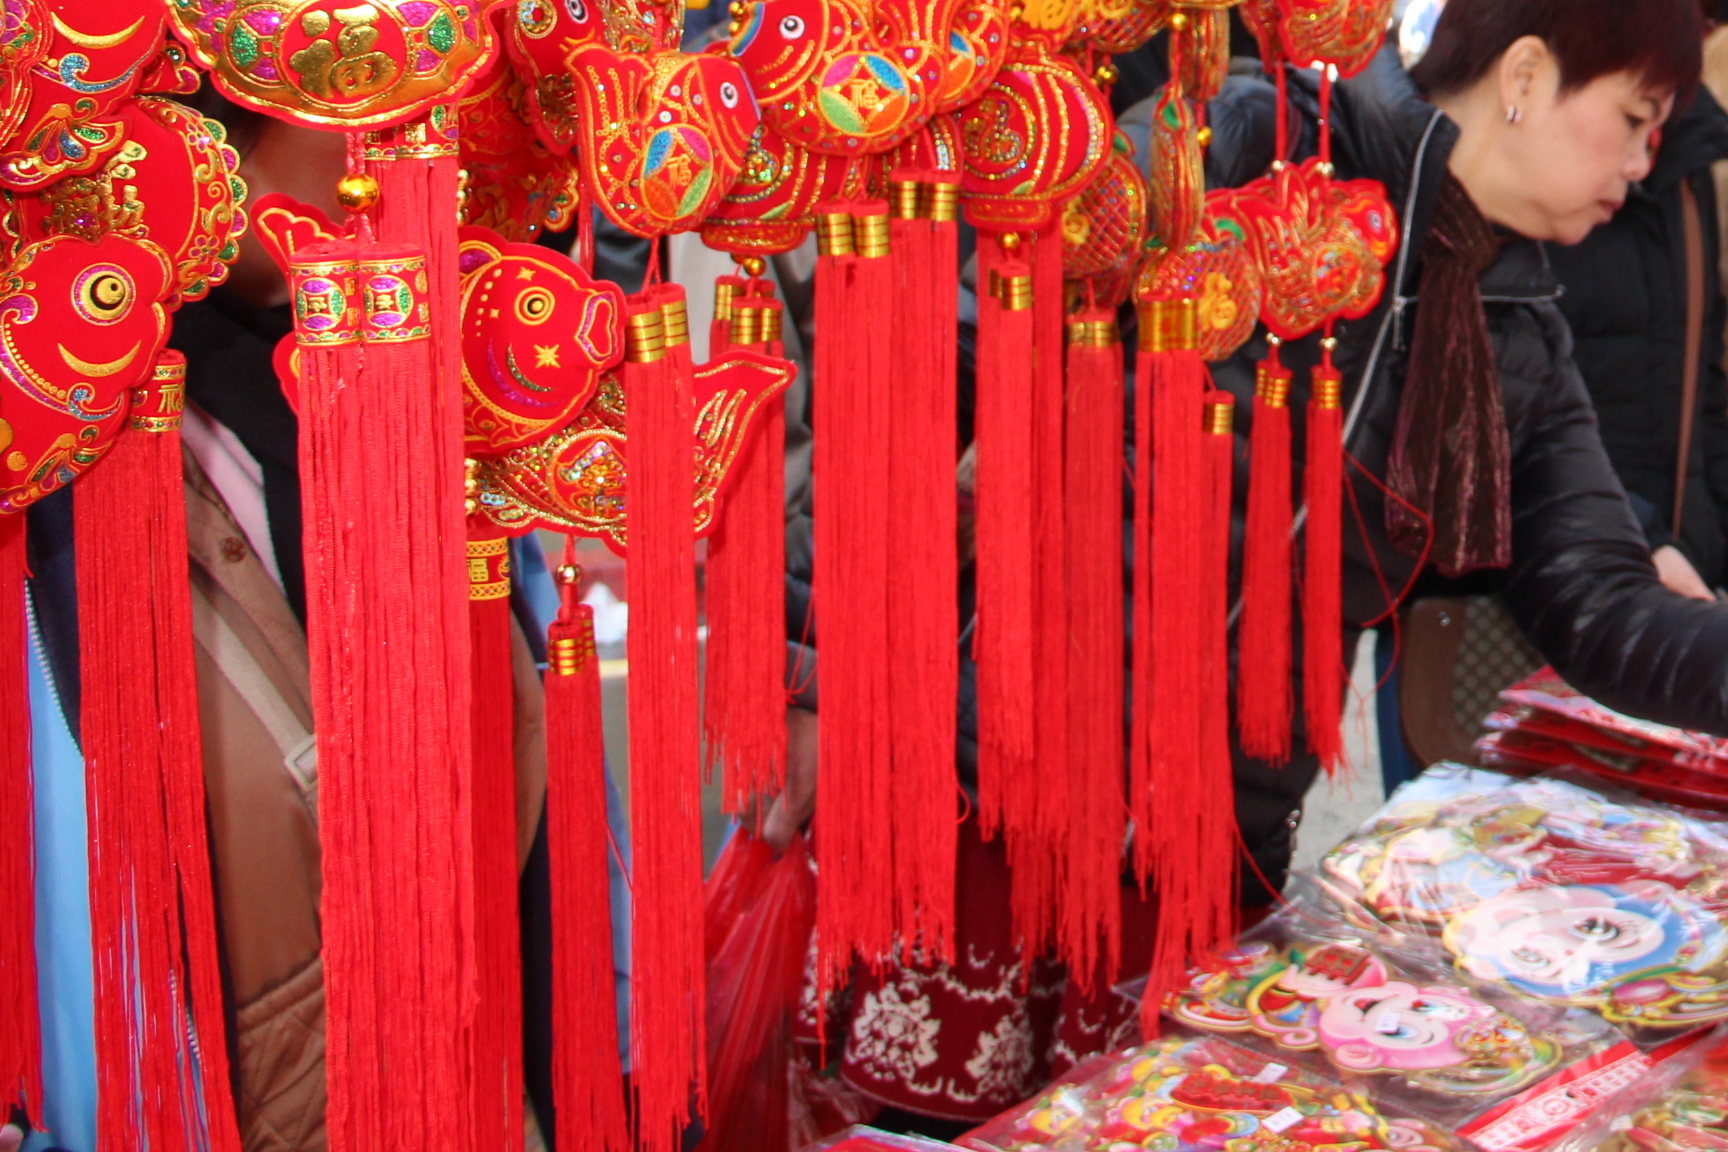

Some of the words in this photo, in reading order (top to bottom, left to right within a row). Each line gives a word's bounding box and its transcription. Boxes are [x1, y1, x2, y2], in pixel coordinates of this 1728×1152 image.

[291, 4, 398, 98] 福
[851, 77, 881, 110] 福
[667, 156, 692, 187] 福
